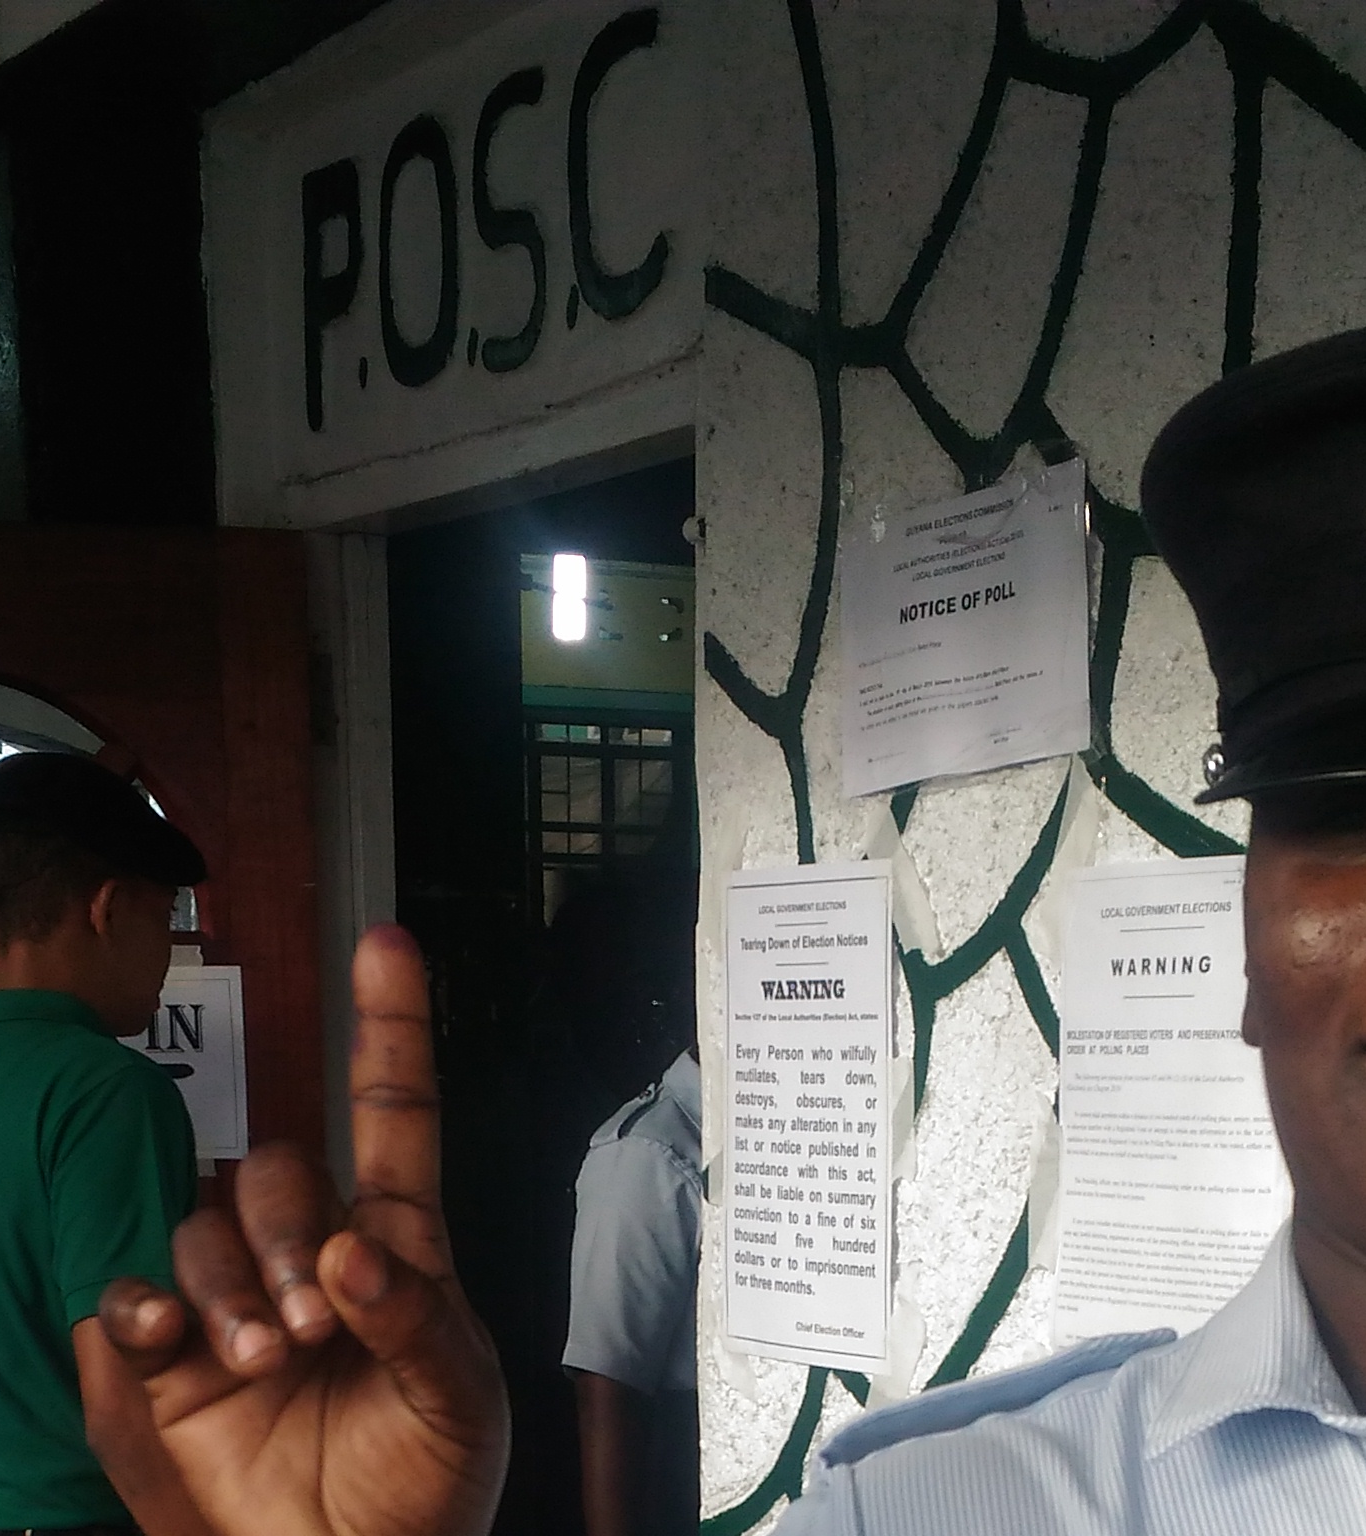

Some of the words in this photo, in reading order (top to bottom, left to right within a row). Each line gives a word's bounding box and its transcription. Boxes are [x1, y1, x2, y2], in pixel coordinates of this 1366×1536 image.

[302, 8, 674, 431] P.O.S.C
[934, 512, 972, 530] ELECTIONS
[900, 597, 956, 625] NOTICE
[962, 591, 981, 612] OF
[984, 581, 1016, 605] POLL
[759, 904, 776, 914] LOCAL
[777, 903, 814, 913] GOVERNMENT
[815, 901, 847, 911] ELECTIONS
[1101, 906, 1124, 919] LOCAL
[1125, 903, 1180, 917] GOVERNMENT
[1182, 901, 1232, 914] ELECTIONS
[741, 937, 766, 953] Tearing
[768, 937, 789, 950] Down
[792, 936, 800, 948] of
[803, 935, 835, 948] Election
[836, 934, 868, 947] Notices
[1111, 955, 1211, 976] WARNING
[761, 979, 845, 1000] WARNING
[1149, 1030, 1173, 1040] VOTERS
[1178, 1030, 1192, 1040] AND
[736, 1044, 760, 1062] Every
[768, 1045, 804, 1061] Person
[811, 1046, 833, 1060] who
[841, 1045, 877, 1064] wilfully
[1088, 1045, 1096, 1054] AT
[1099, 1045, 1123, 1055] POLLING
[735, 1068, 780, 1085] mutilates,
[800, 1070, 825, 1085] tears
[845, 1071, 877, 1087] down,
[735, 1091, 777, 1109] destroys,
[796, 1094, 846, 1110] obscures,
[865, 1097, 877, 1110] or
[735, 1115, 764, 1130] makes
[768, 1119, 786, 1134] any
[791, 1117, 839, 1132] alteration
[843, 1118, 853, 1132] in
[857, 1122, 876, 1138] any
[735, 1137, 748, 1151] list
[754, 1140, 764, 1152] or
[771, 1140, 802, 1154] notice
[808, 1143, 859, 1158] published
[866, 1143, 876, 1158] in
[735, 1162, 788, 1177] accordance
[798, 1164, 818, 1179] with
[828, 1165, 847, 1180] this
[857, 1167, 876, 1184] act,
[735, 1183, 755, 1197] shall
[760, 1185, 772, 1199] be
[777, 1185, 804, 1200] liable
[809, 1190, 822, 1202] on
[828, 1192, 876, 1209] summary
[734, 1207, 782, 1223] conviction
[788, 1211, 799, 1224] to
[805, 1213, 811, 1225] a
[817, 1211, 836, 1228] fine
[843, 1213, 854, 1228] of
[860, 1215, 876, 1230] six
[734, 1228, 777, 1245] thousand
[795, 1233, 814, 1249] five
[833, 1236, 876, 1254] hundred
[734, 1250, 765, 1267] dollars
[771, 1257, 781, 1269] or
[788, 1257, 799, 1271] to
[805, 1257, 876, 1278] imprisonment
[735, 1271, 748, 1287] for
[750, 1274, 772, 1290] three
[774, 1278, 816, 1296] months.
[796, 1321, 813, 1334] Chief
[814, 1323, 841, 1336] Election
[842, 1326, 865, 1339] Officer
